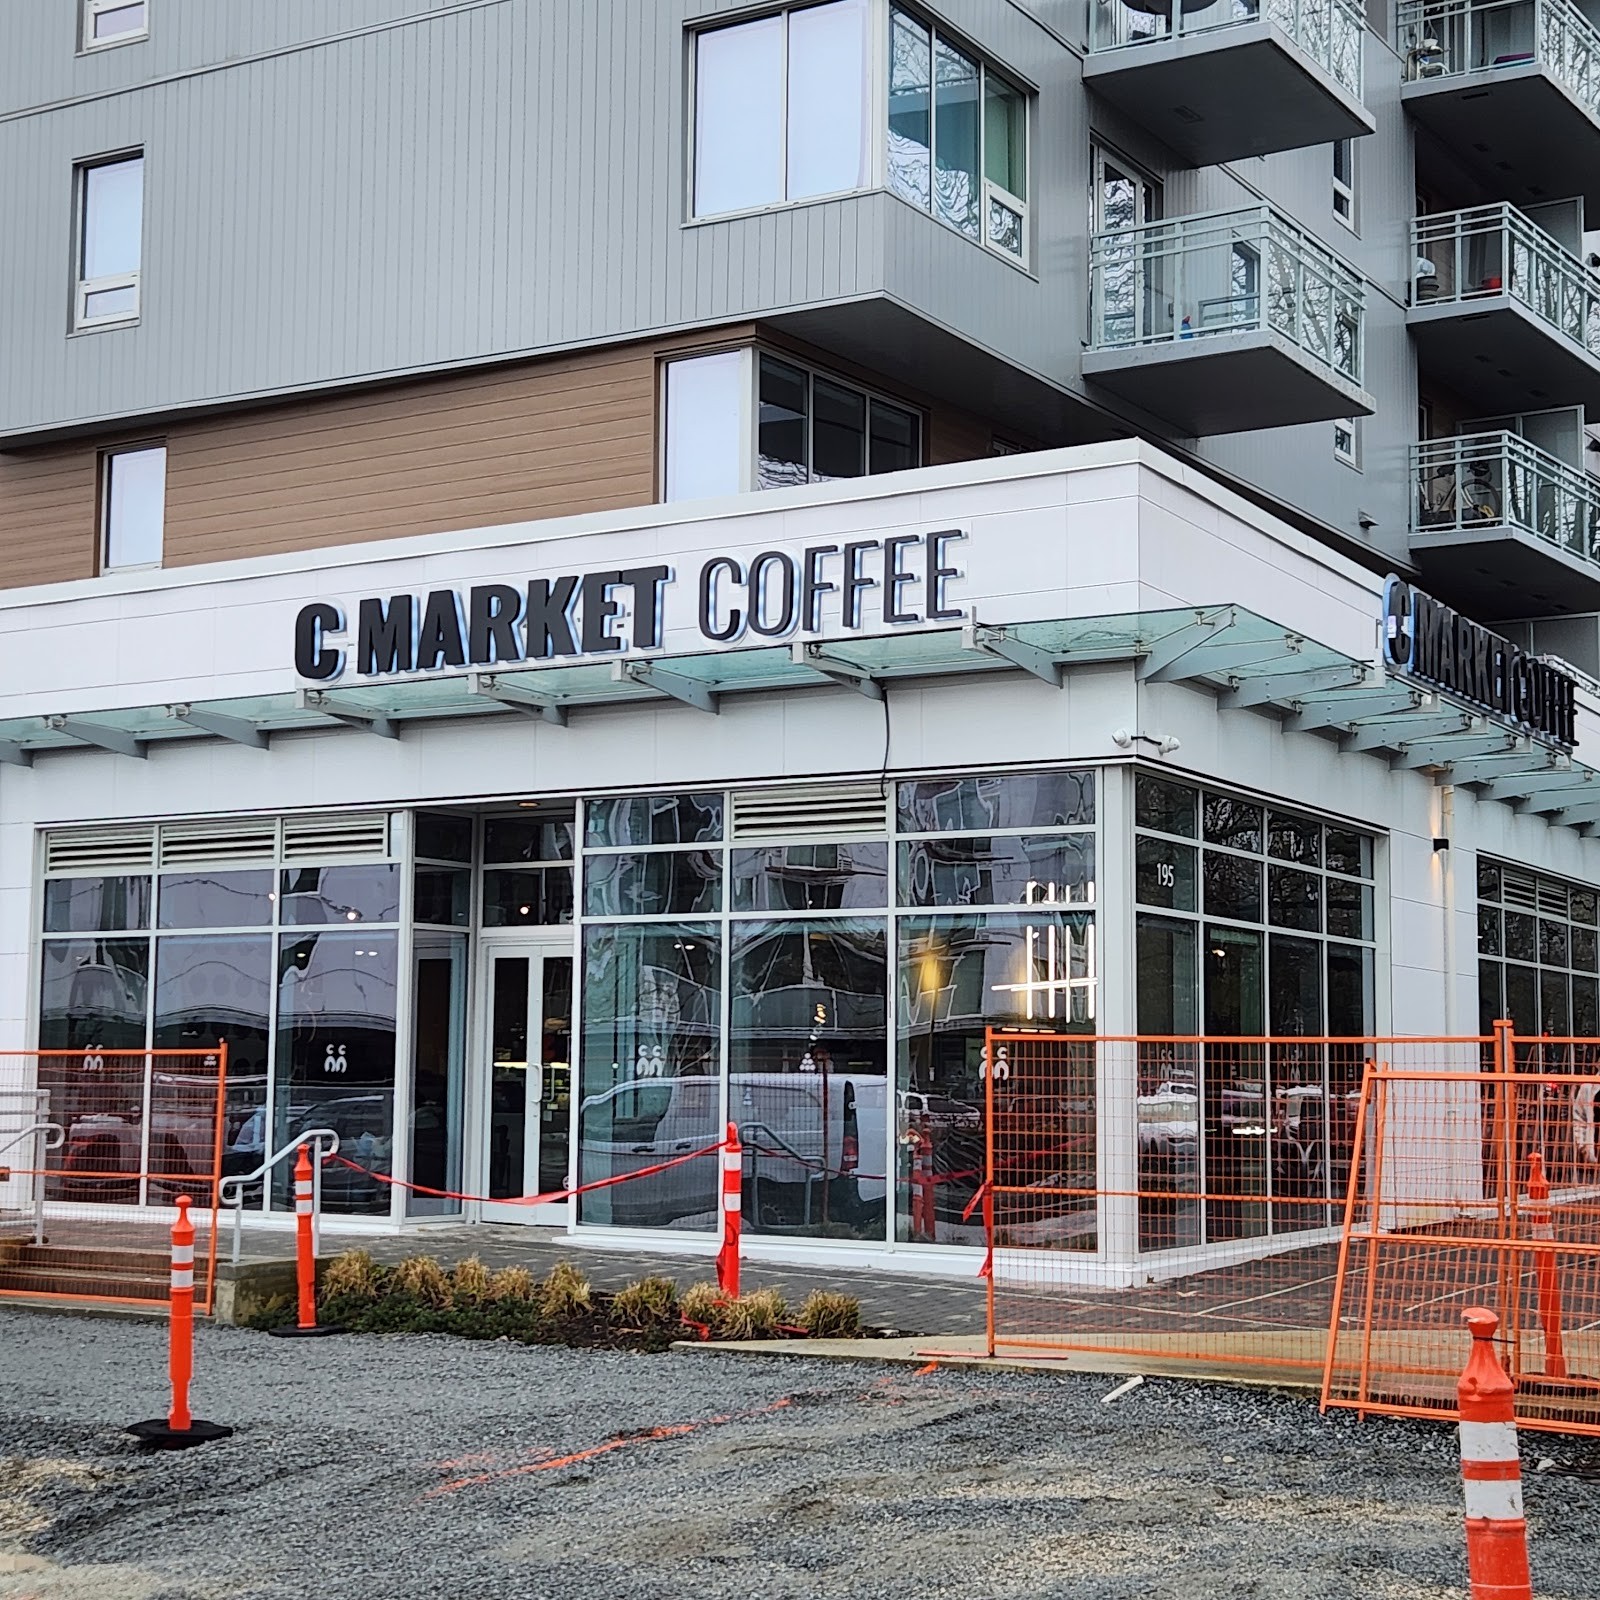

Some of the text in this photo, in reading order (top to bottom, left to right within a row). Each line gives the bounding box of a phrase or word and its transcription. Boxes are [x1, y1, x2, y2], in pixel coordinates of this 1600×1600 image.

[294, 529, 968, 681] C MARKET COFFEE
[1413, 592, 1515, 716] MARKET
[1156, 862, 1175, 888] 195
